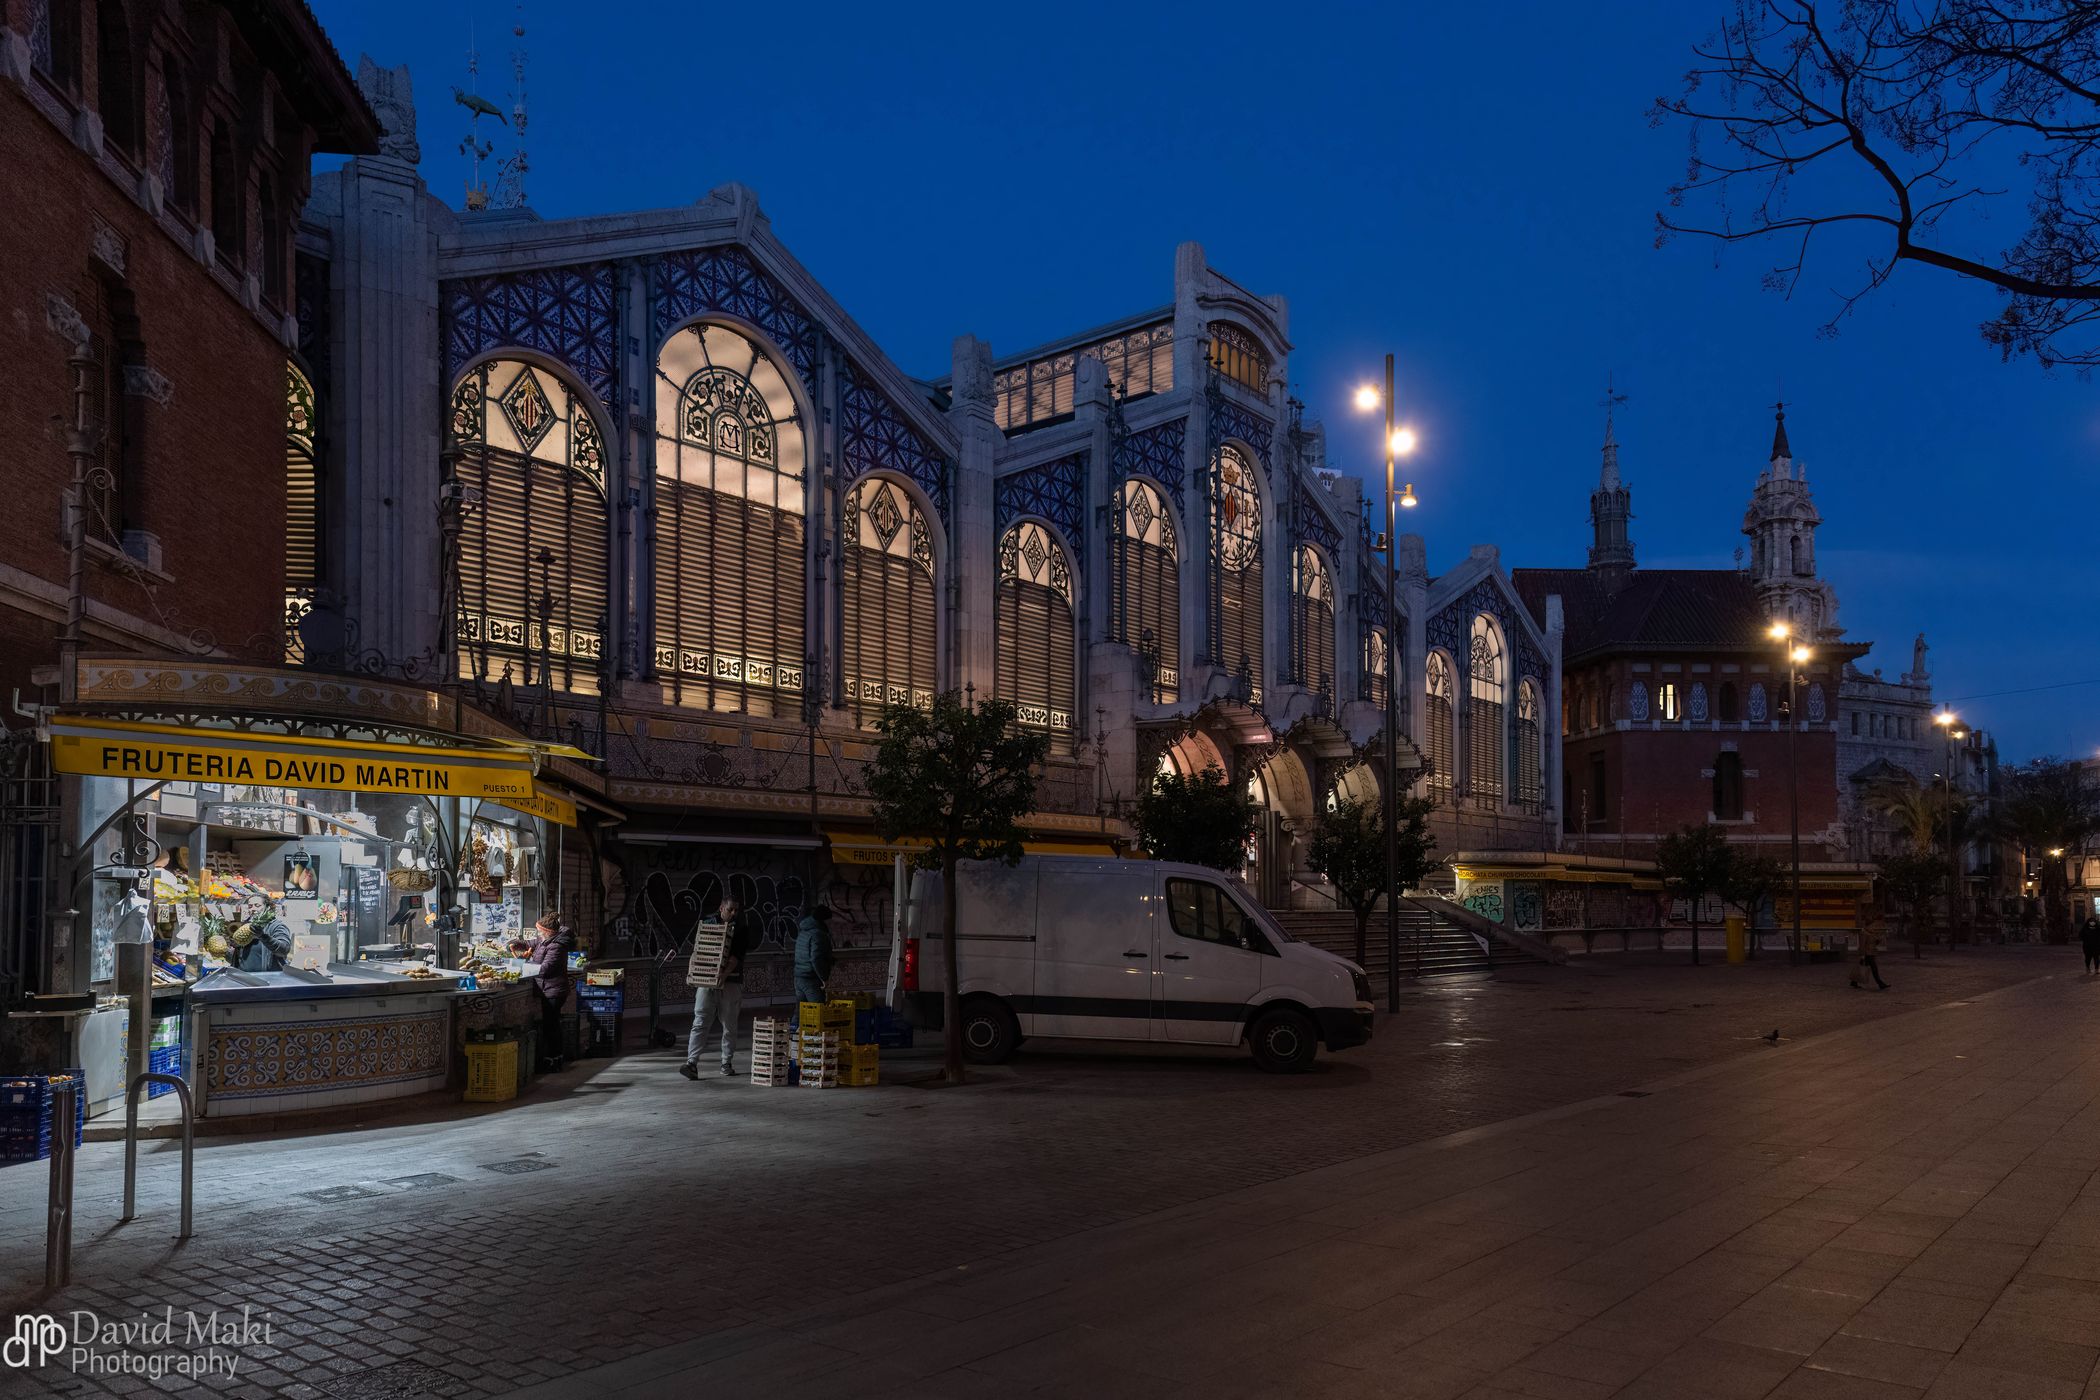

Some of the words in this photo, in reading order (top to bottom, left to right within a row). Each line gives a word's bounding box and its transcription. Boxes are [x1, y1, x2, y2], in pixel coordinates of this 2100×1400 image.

[102, 747, 254, 779] FRUTERIA
[265, 758, 345, 784] DAVID
[356, 764, 449, 790] MARTIN
[483, 783, 518, 794] PUESTO
[853, 850, 888, 862] FRUTOS
